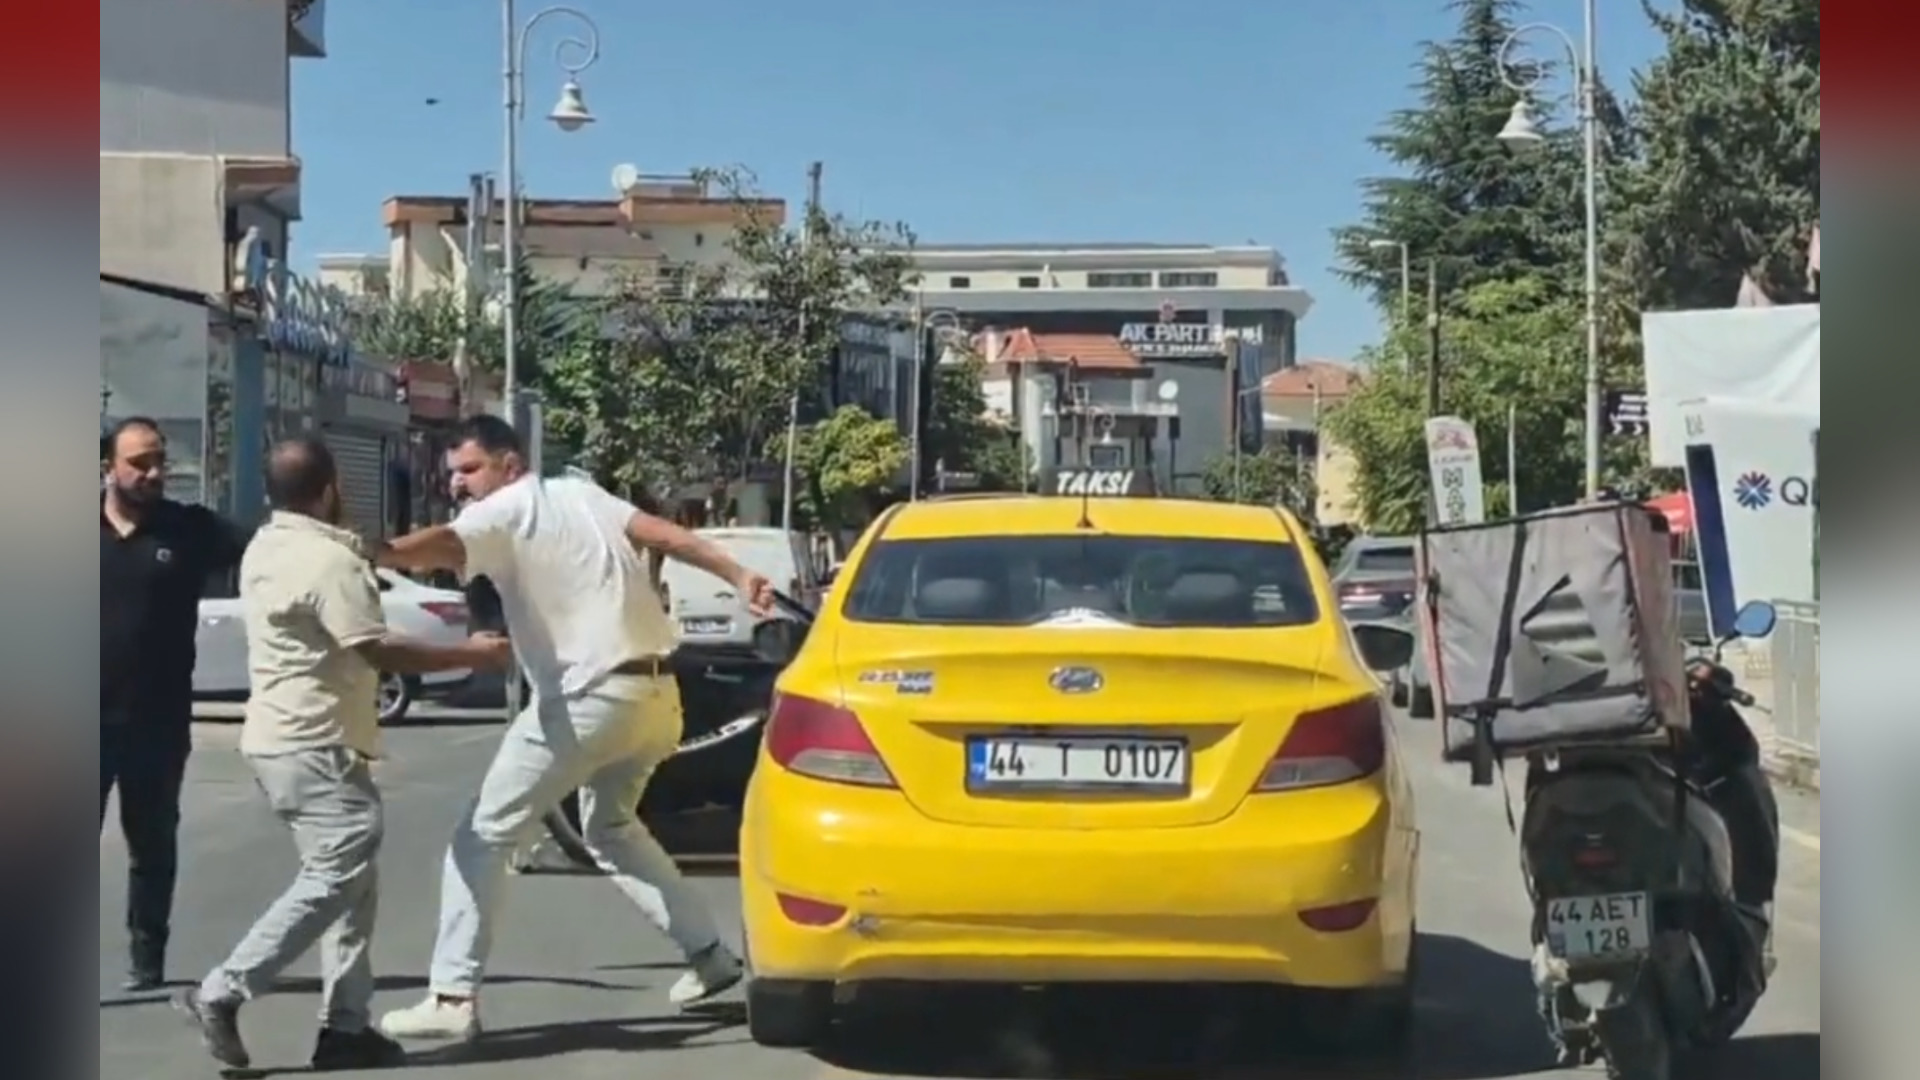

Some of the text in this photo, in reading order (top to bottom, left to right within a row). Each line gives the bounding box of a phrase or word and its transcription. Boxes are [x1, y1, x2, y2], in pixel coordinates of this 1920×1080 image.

[1120, 322, 1149, 342] AK
[1057, 470, 1134, 494] TAKSI
[990, 742, 1180, 778] 44 T 0107
[1551, 895, 1643, 924] 44 AET
[1585, 926, 1630, 953] 128
